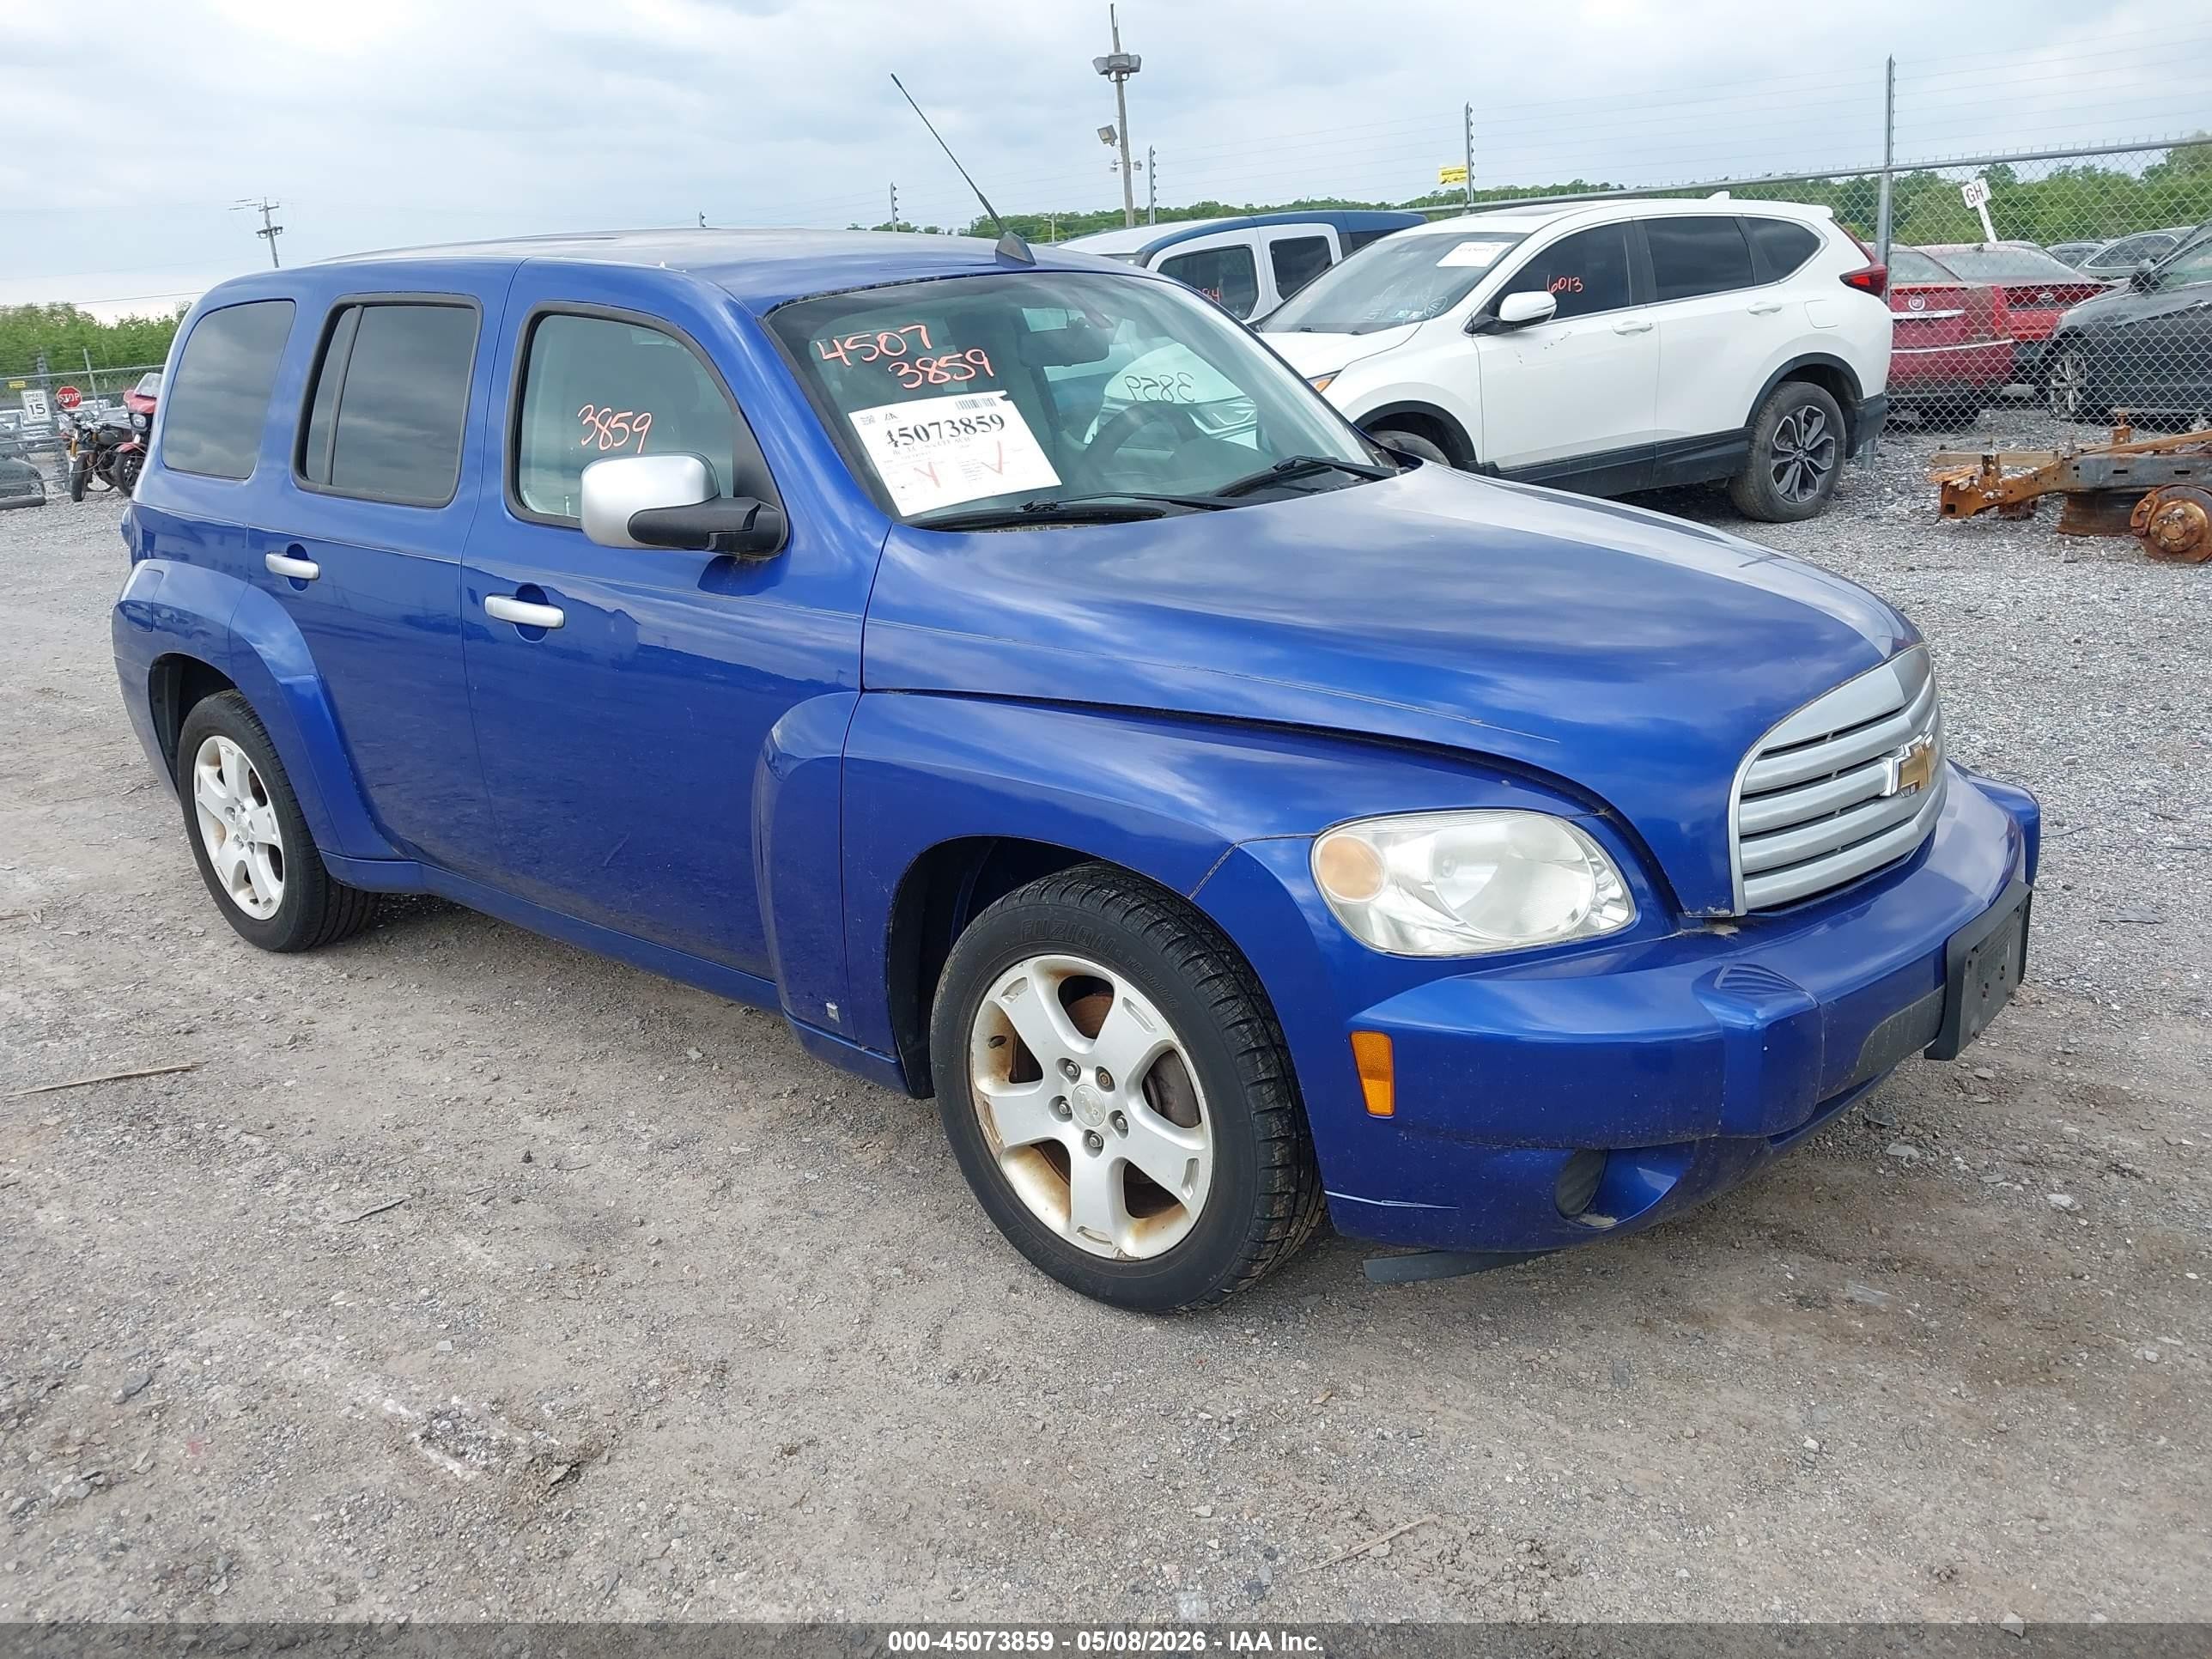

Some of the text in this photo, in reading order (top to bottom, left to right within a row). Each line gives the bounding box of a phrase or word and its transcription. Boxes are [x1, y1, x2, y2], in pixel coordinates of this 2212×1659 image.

[1966, 183, 1984, 204] GH
[1547, 274, 1584, 294] 6013
[817, 325, 933, 366] 4507
[887, 349, 994, 388] 3859
[29, 404, 46, 415] 15
[58, 392, 80, 403] STOP
[577, 404, 653, 454] 3859
[885, 414, 1005, 448] 45073859
